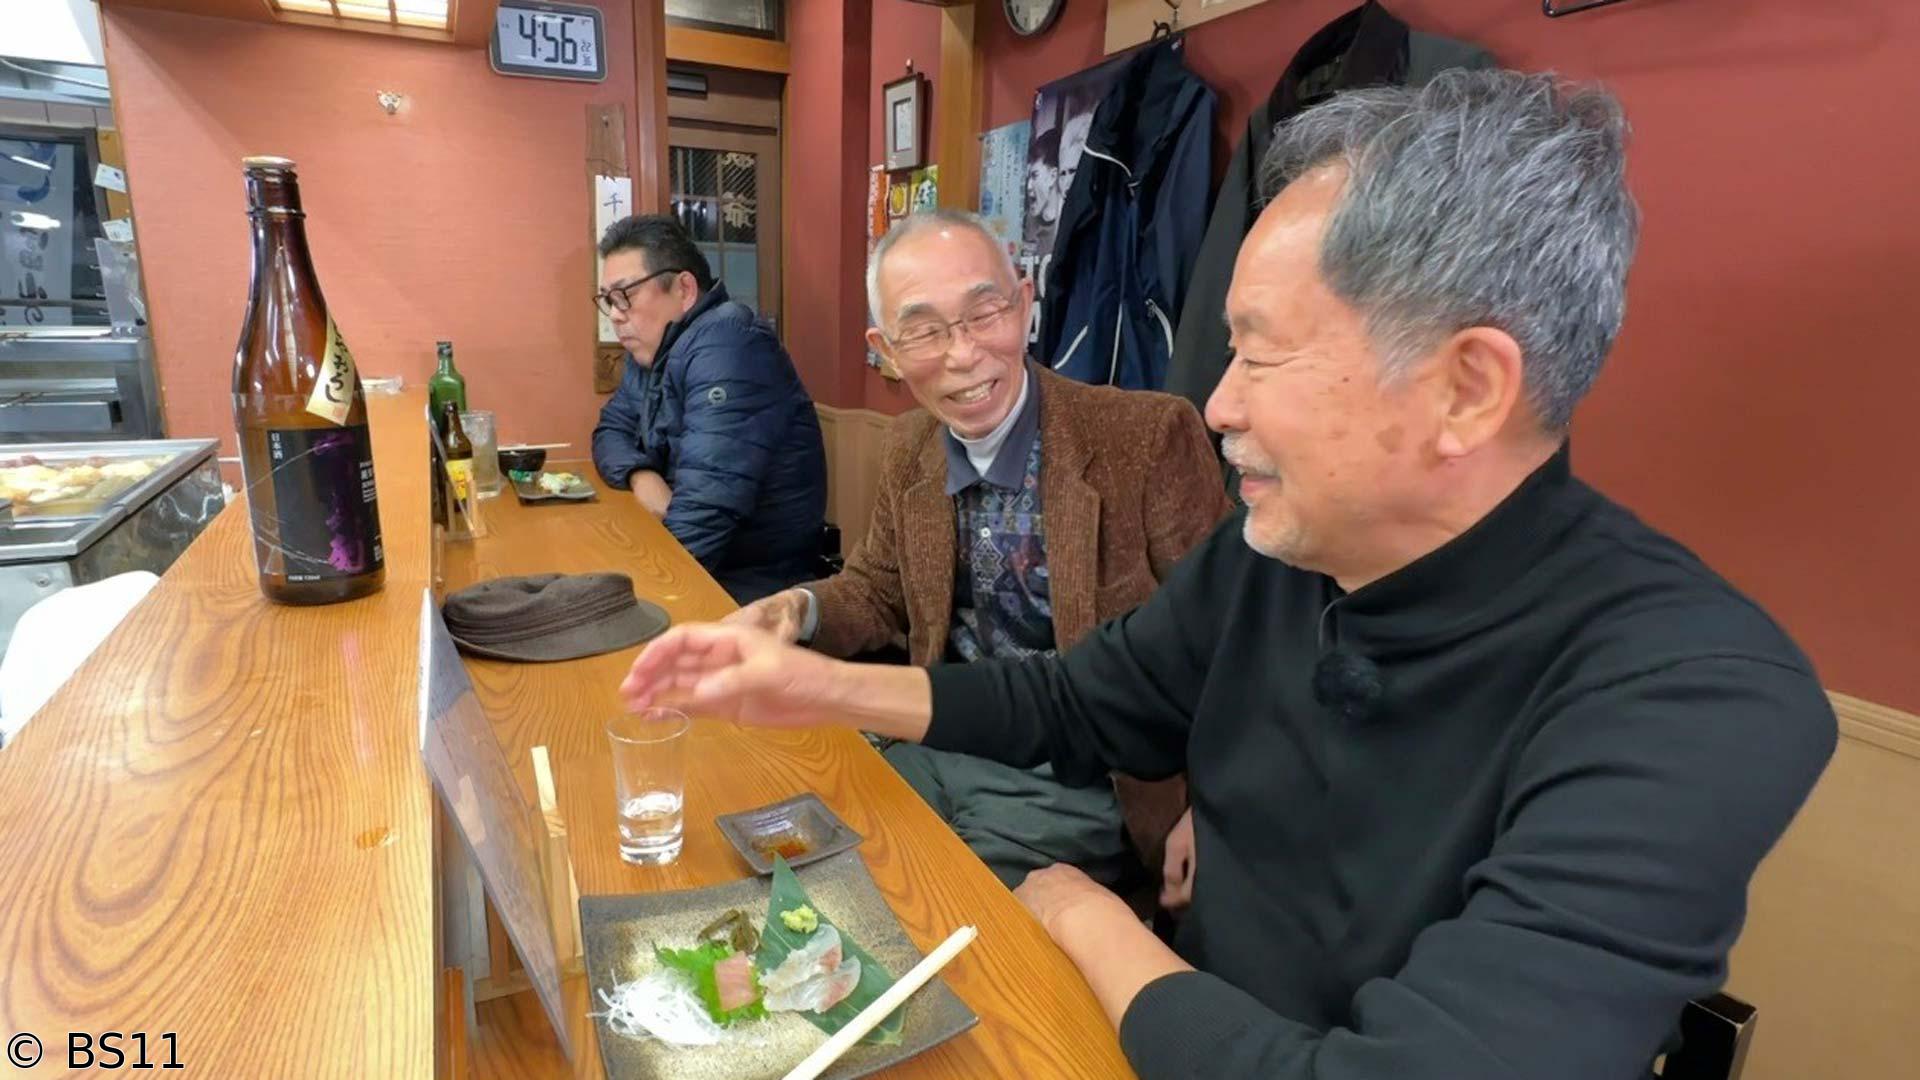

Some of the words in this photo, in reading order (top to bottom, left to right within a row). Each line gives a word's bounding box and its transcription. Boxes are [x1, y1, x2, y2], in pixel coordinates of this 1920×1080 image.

[519, 14, 577, 65] 4:56
[271, 432, 283, 460] 日本酒
